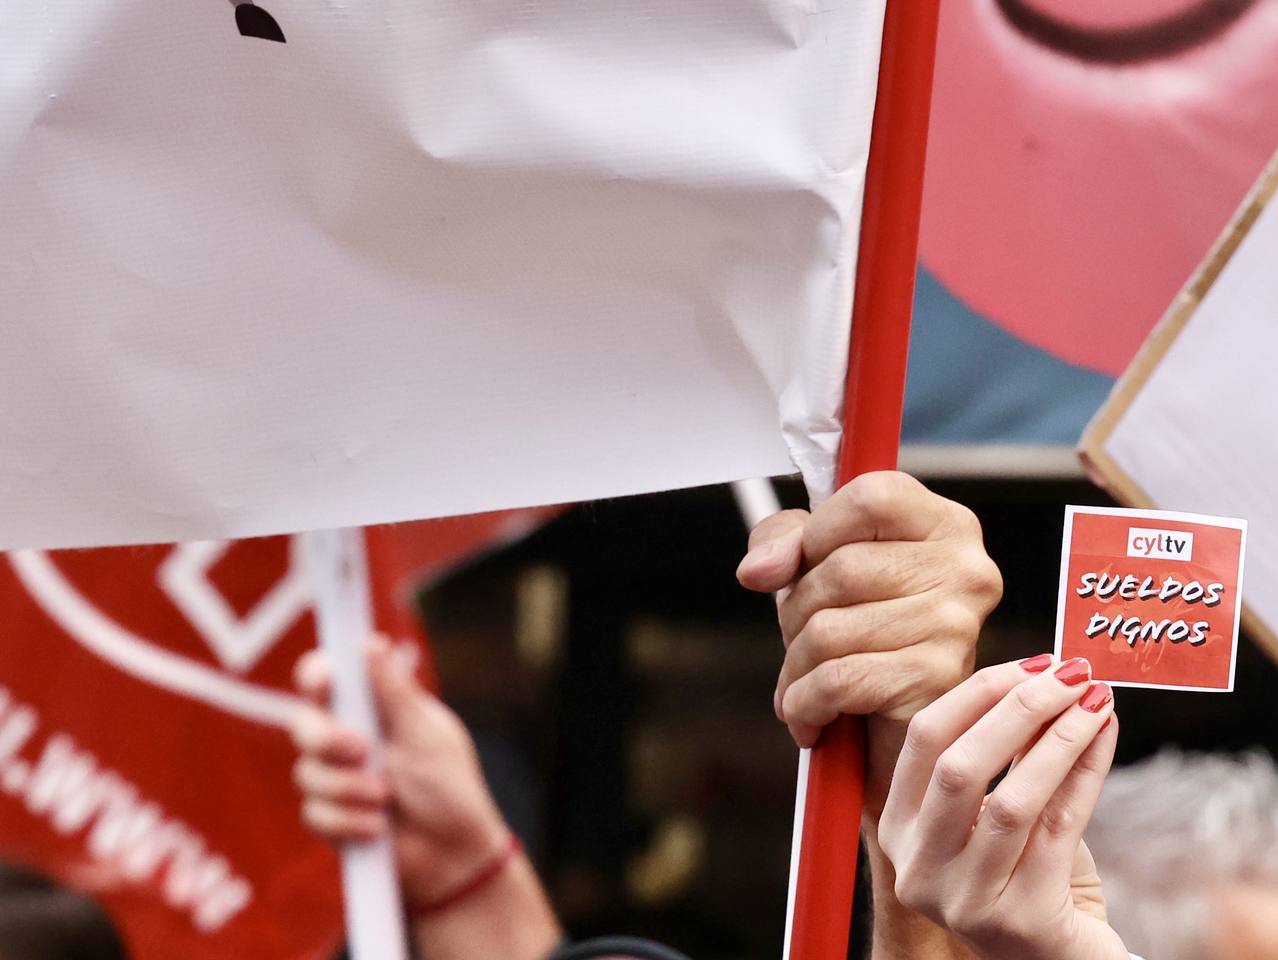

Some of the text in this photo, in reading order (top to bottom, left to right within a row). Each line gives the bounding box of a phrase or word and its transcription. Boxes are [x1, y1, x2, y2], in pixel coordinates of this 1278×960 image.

[1132, 533, 1186, 556] cyltv
[1076, 572, 1225, 607] SUELDOS
[1085, 612, 1210, 648] DIGNOS
